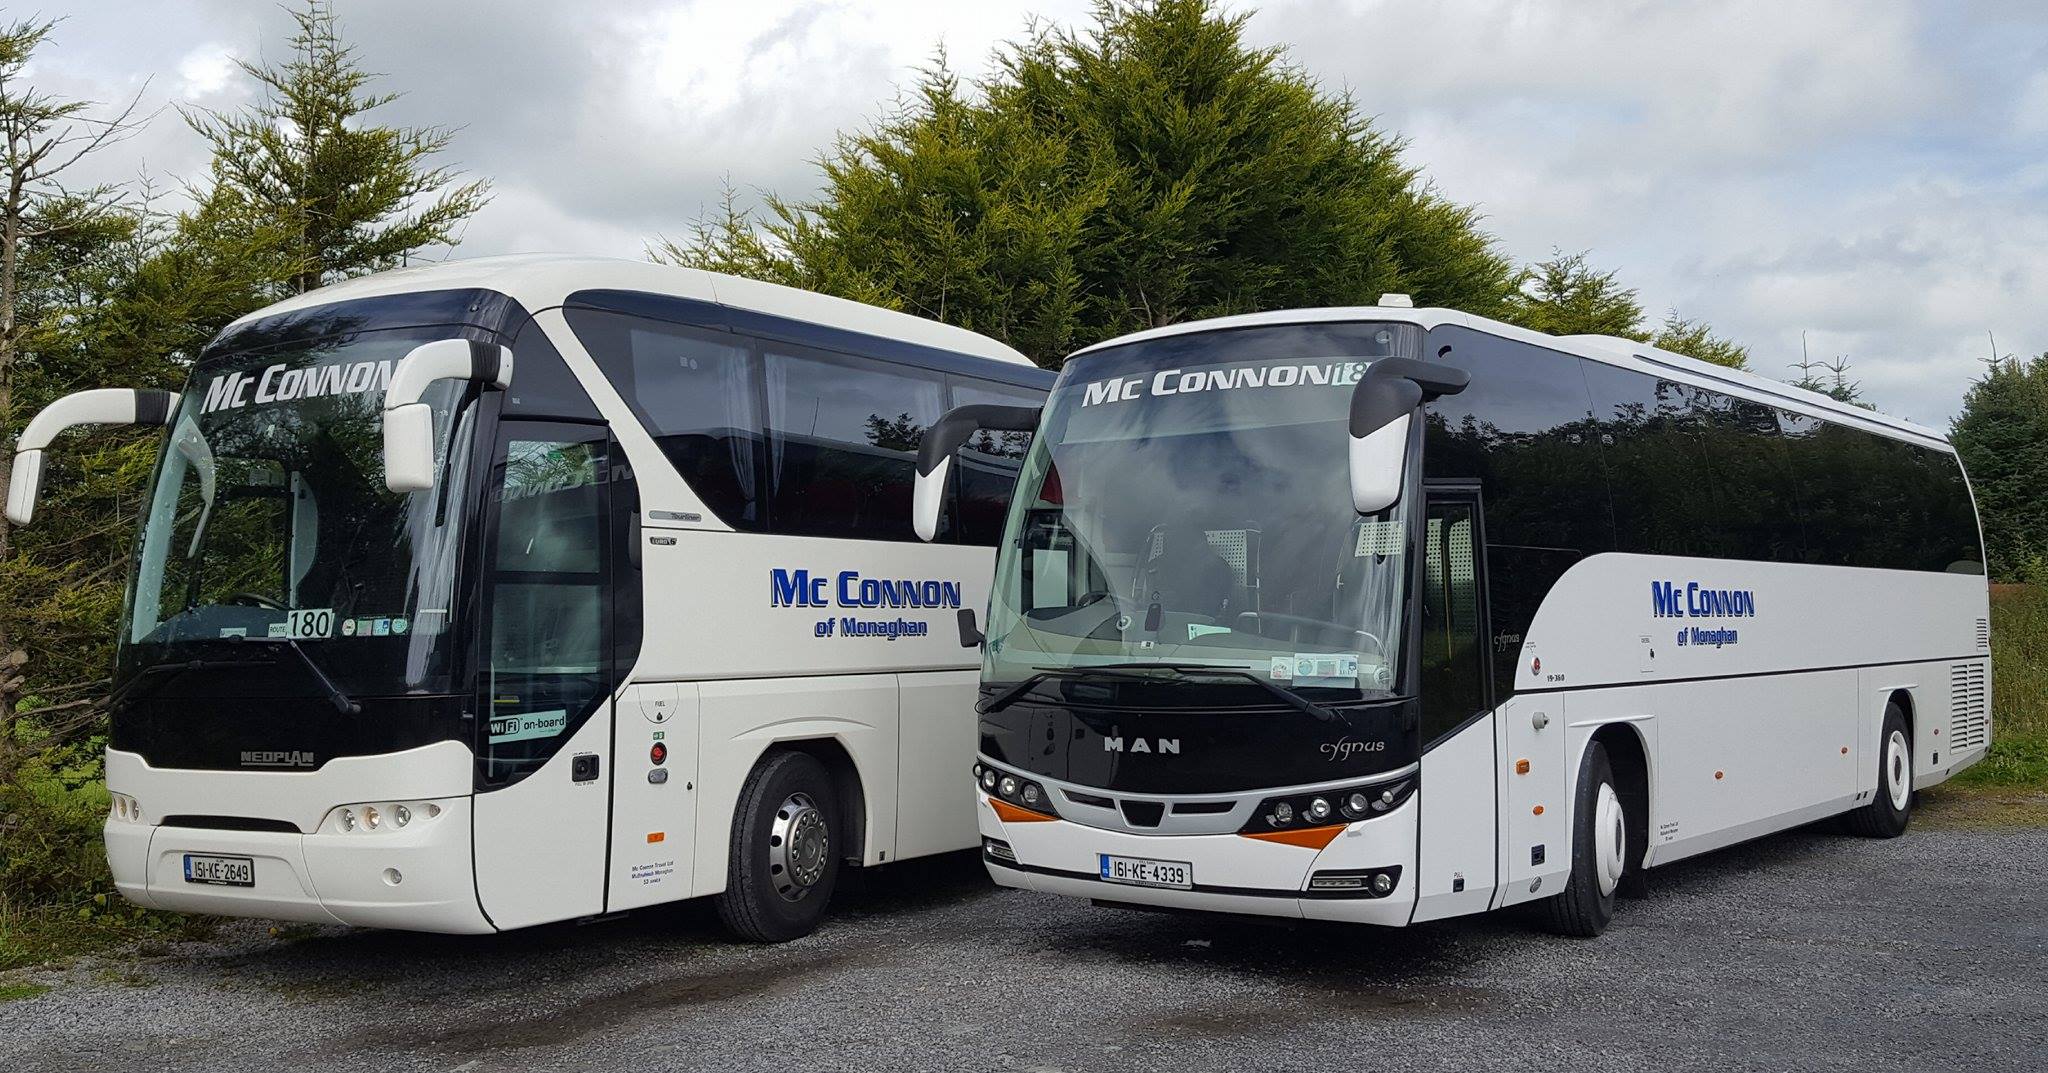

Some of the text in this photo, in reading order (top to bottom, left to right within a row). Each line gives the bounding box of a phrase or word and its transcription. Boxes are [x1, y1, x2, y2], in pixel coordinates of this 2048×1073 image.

[200, 371, 256, 415] Mc
[1081, 377, 1143, 408] Mc
[770, 568, 829, 608] Mc
[1651, 580, 1684, 618] Mc
[269, 624, 286, 633] ROUTE
[290, 611, 330, 638] 180
[814, 617, 929, 641] of Monaghan
[1676, 626, 1738, 649] of Monaghan
[523, 716, 565, 731] on-board
[1104, 736, 1181, 754] MAN
[1319, 735, 1385, 762] cygnus
[240, 750, 314, 767] NEOPLAN
[194, 861, 249, 881] 151-KE-2649
[1113, 860, 1184, 884] 161-KE-4339
